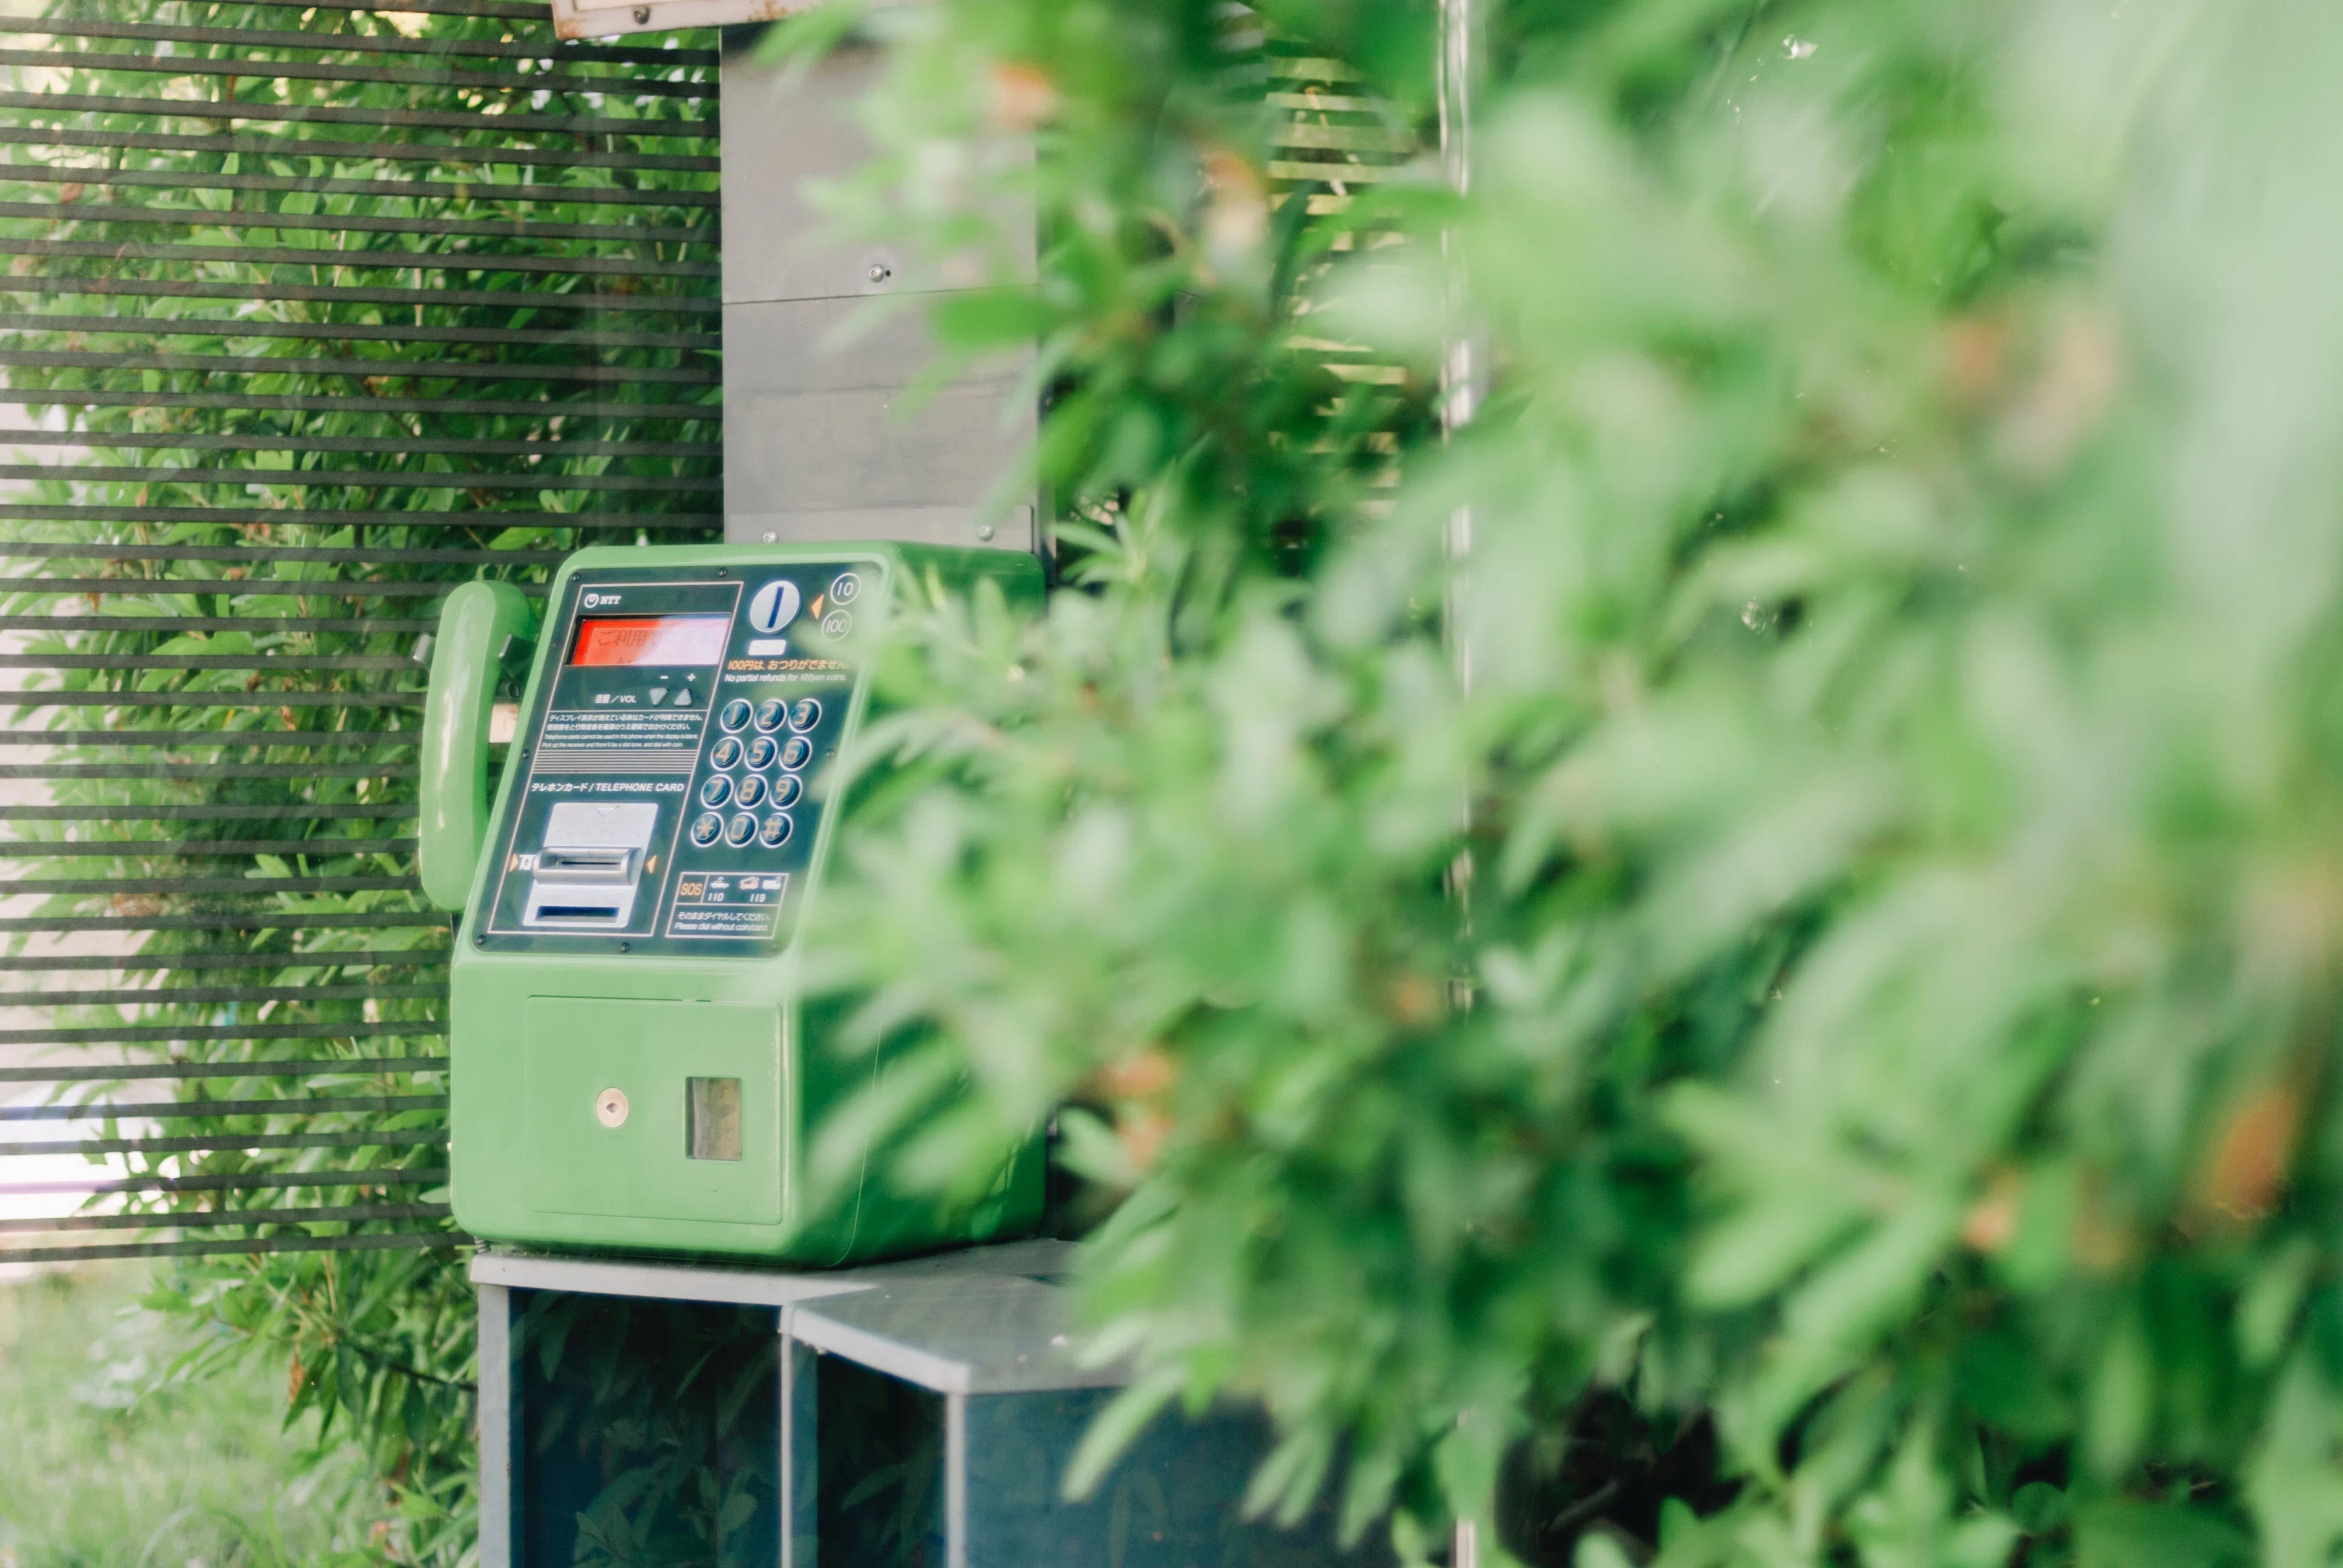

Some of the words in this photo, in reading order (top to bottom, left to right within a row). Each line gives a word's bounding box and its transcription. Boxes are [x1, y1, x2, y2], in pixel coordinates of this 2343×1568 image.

[837, 582, 854, 596] 10
[600, 595, 621, 605] NTT
[826, 619, 848, 633] 100
[725, 674, 735, 682] No
[736, 673, 759, 683] partial
[759, 673, 786, 682] refunds
[787, 673, 798, 682] for
[730, 704, 739, 725] 1
[761, 704, 775, 725] 2
[794, 704, 810, 725] 3
[715, 742, 732, 763] 4
[750, 741, 767, 763] 5
[783, 741, 800, 762] 6
[531, 783, 588, 792] テレホンカード
[595, 783, 654, 792] TELEPHONE
[655, 783, 684, 792] CARD
[709, 780, 723, 801] 7
[740, 779, 756, 802] 8
[776, 780, 790, 801] 9
[730, 817, 747, 840] 0
[681, 883, 703, 895] SOS
[707, 892, 724, 902] 110
[750, 893, 766, 903] 119
